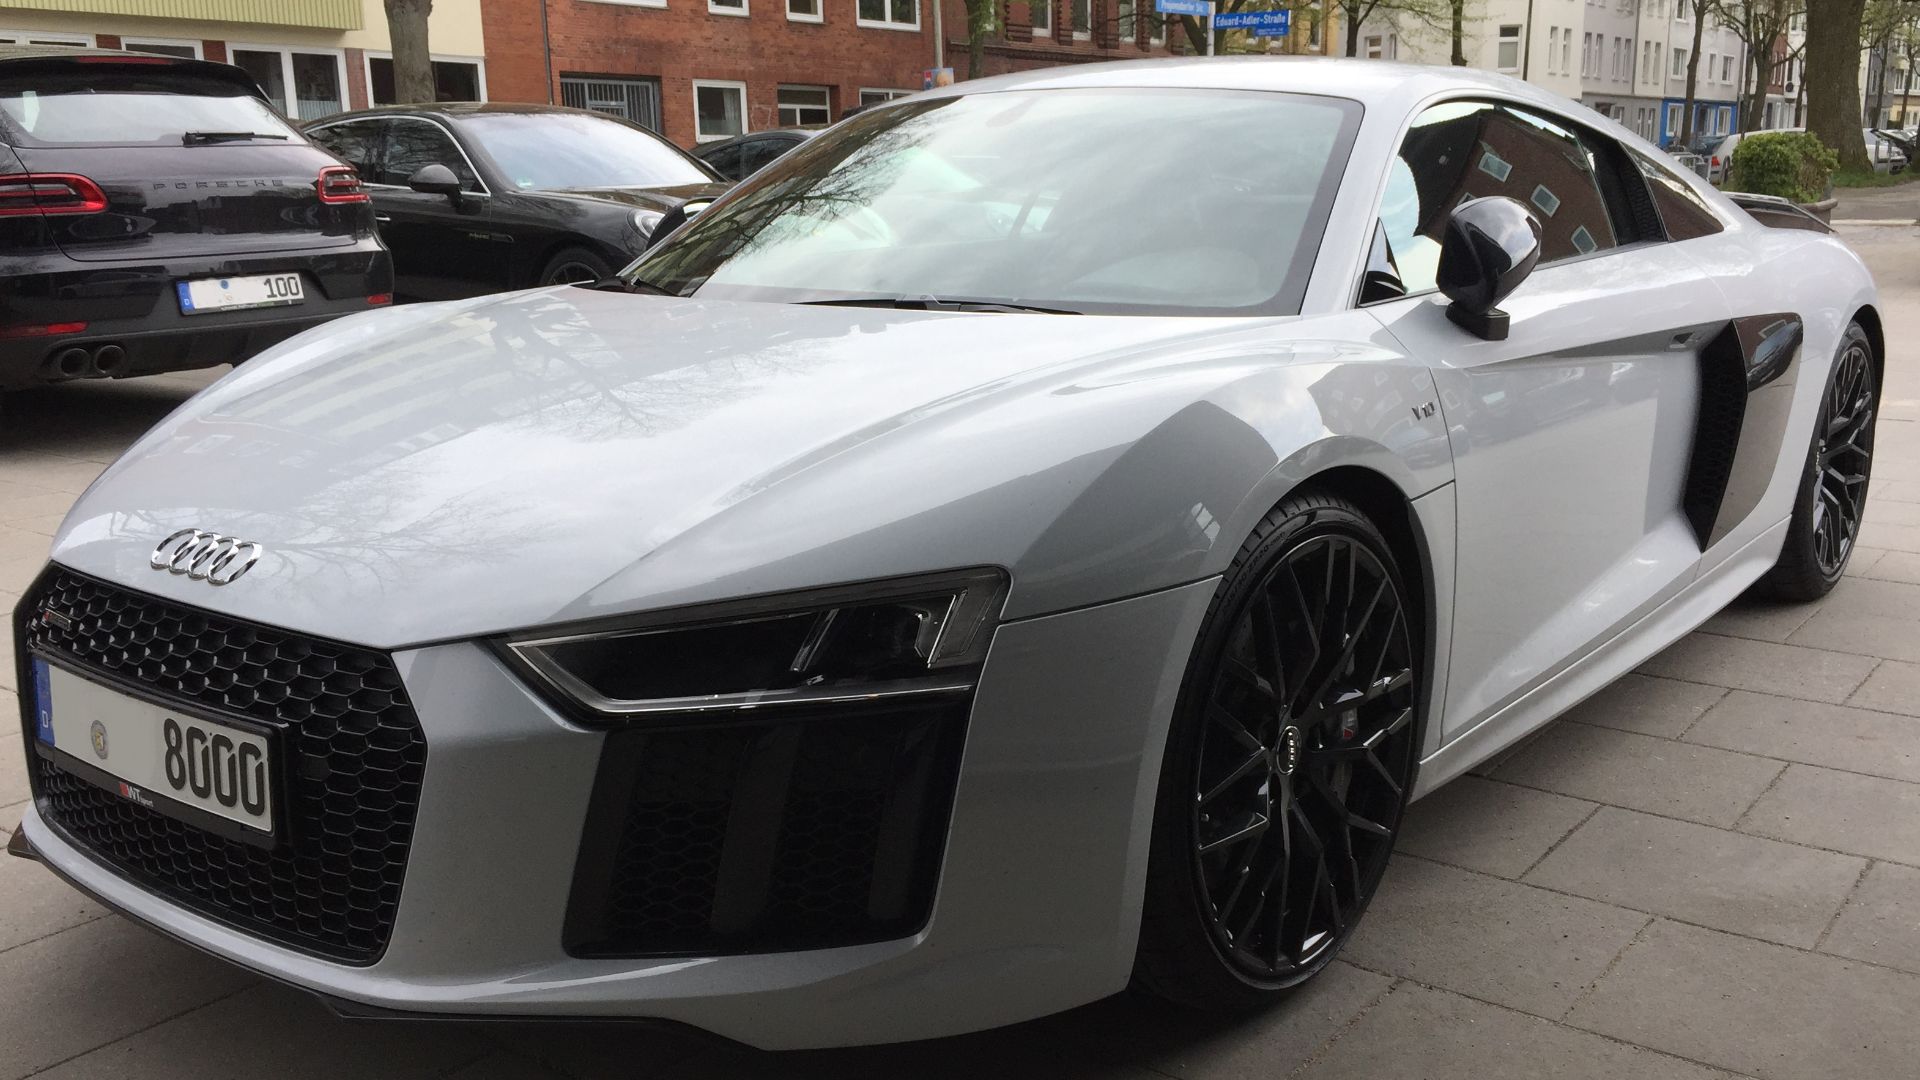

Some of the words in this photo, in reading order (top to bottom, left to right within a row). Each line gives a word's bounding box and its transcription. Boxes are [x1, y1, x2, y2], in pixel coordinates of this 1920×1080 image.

[1215, 13, 1286, 27] Eduard-Adler-Straße
[264, 276, 300, 298] 100
[1411, 401, 1435, 421] V10
[42, 710, 49, 728] D
[163, 718, 266, 817] 8000
